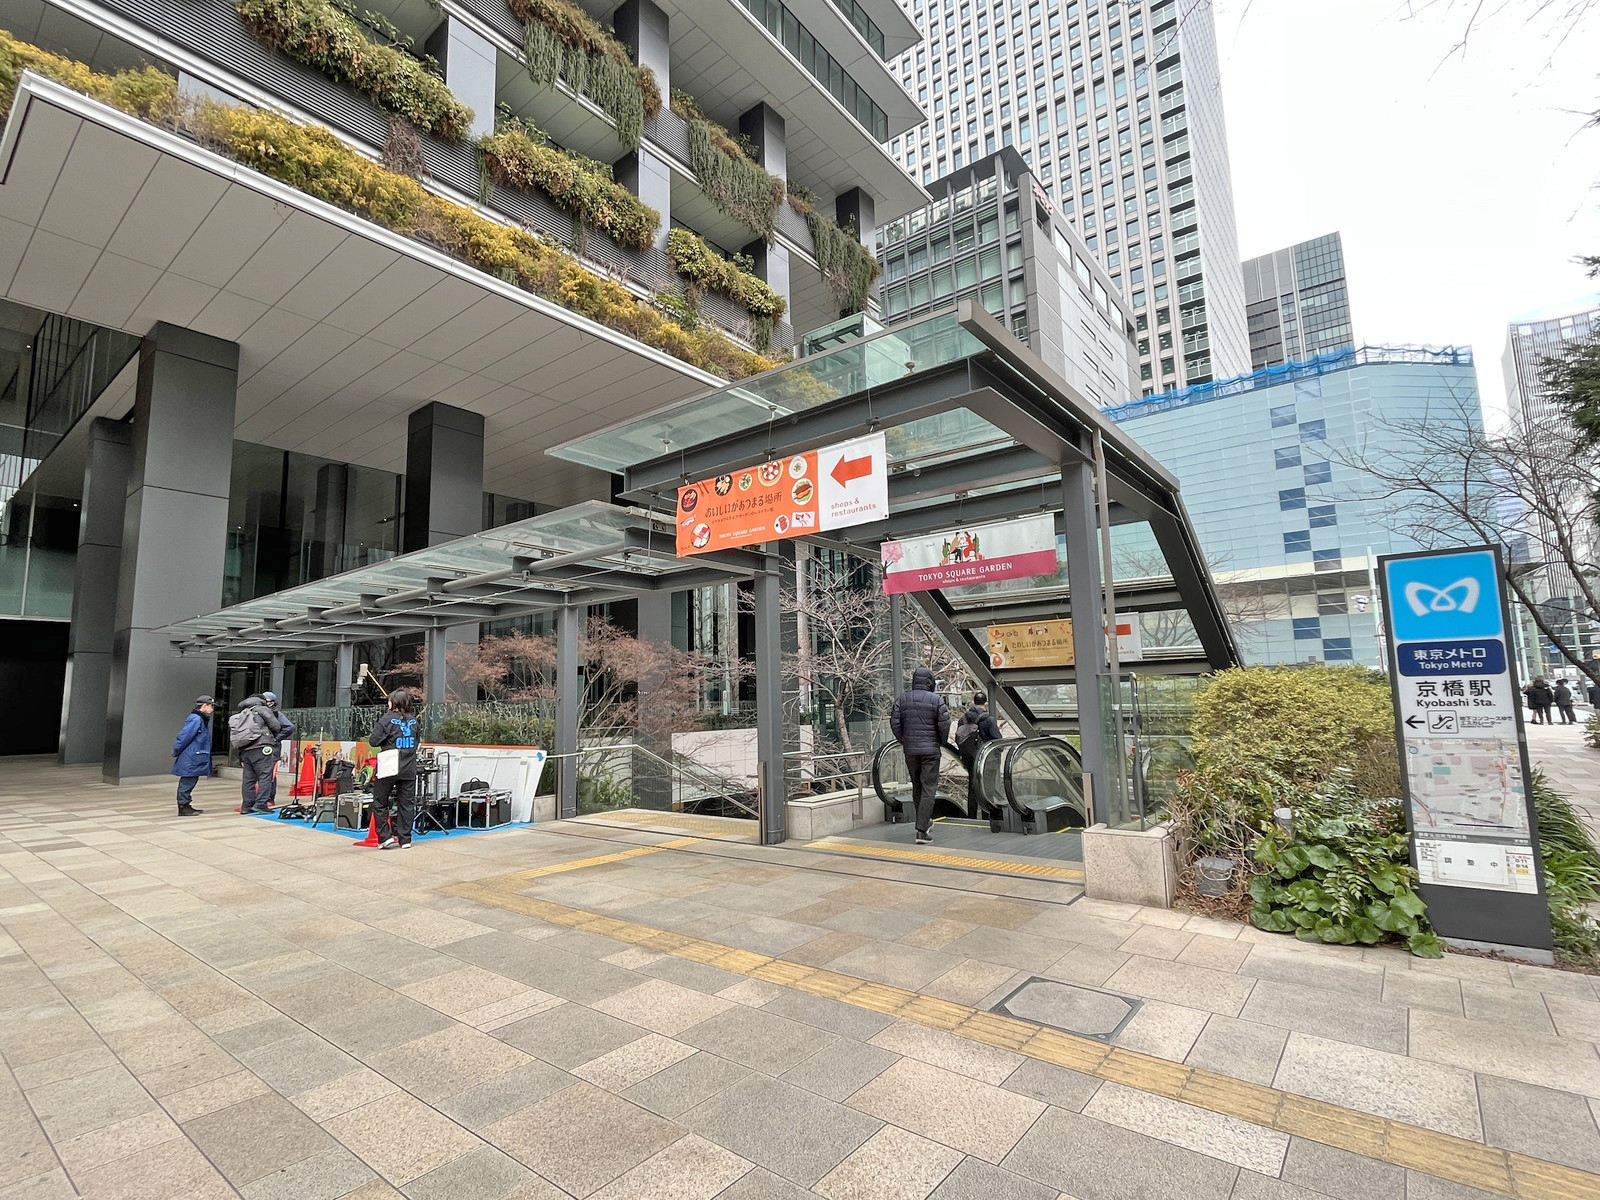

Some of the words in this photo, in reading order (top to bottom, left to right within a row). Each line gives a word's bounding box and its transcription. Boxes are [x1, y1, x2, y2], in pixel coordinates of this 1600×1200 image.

[705, 491, 782, 518] おいしいがあつまる場所
[831, 500, 853, 510] shops
[854, 496, 860, 505] &
[831, 503, 877, 518] restaurants
[918, 571, 944, 582] TOKYO
[946, 567, 976, 579] SQUARE
[979, 562, 1013, 574] GARDEN
[1012, 638, 1069, 649] たのしいがあつまる場所
[1413, 648, 1487, 661] 東京メトロ
[1419, 661, 1449, 670] Tokyo
[1451, 661, 1483, 669] Metro
[1415, 679, 1493, 697] 京橋駅
[1416, 698, 1470, 709] Kyobashi
[1473, 698, 1496, 707] Sta.
[396, 737, 414, 748] ONE
